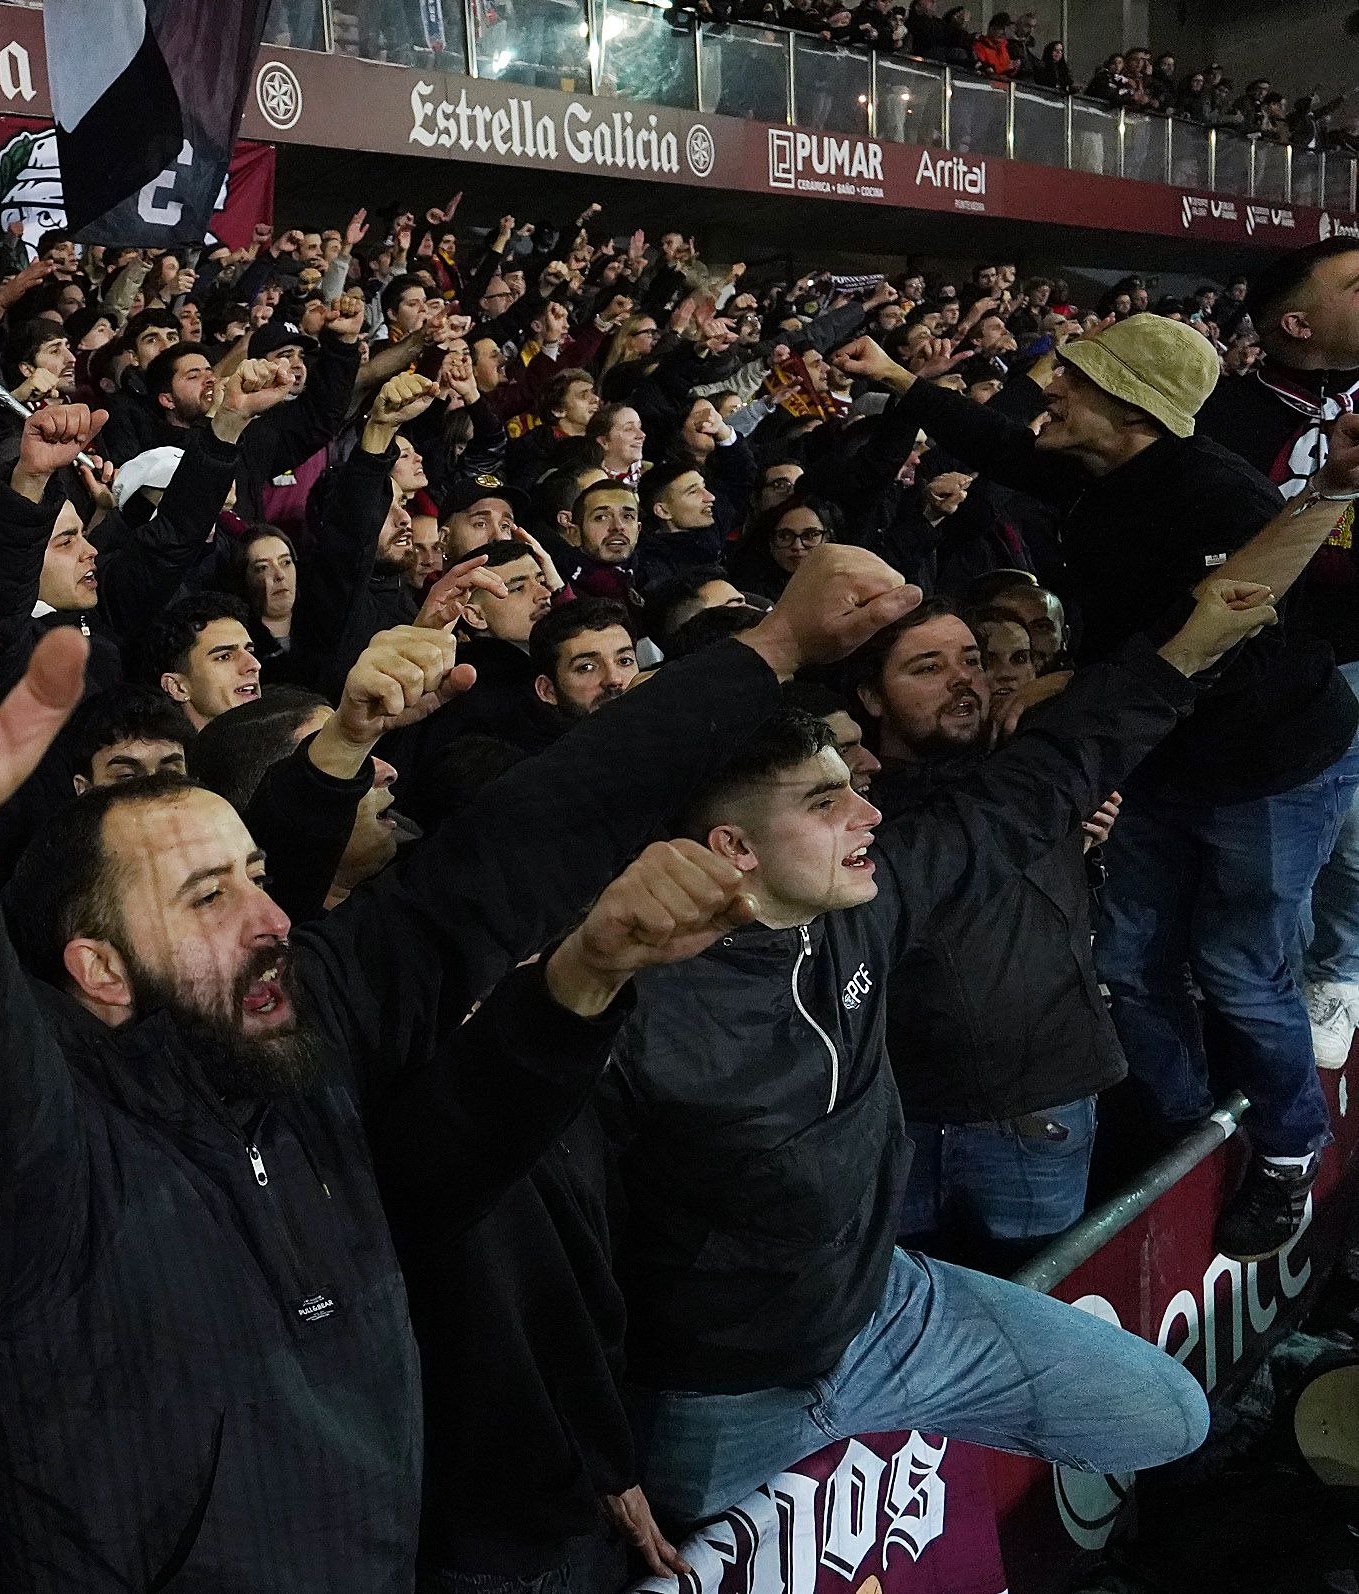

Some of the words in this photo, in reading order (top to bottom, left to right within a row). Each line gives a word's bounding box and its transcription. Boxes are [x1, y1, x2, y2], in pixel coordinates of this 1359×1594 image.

[409, 80, 559, 160] Estrella
[563, 101, 680, 174] Galicia
[796, 132, 884, 181] PUMAR
[915, 150, 986, 195] Arrital
[846, 962, 873, 1003] PCF
